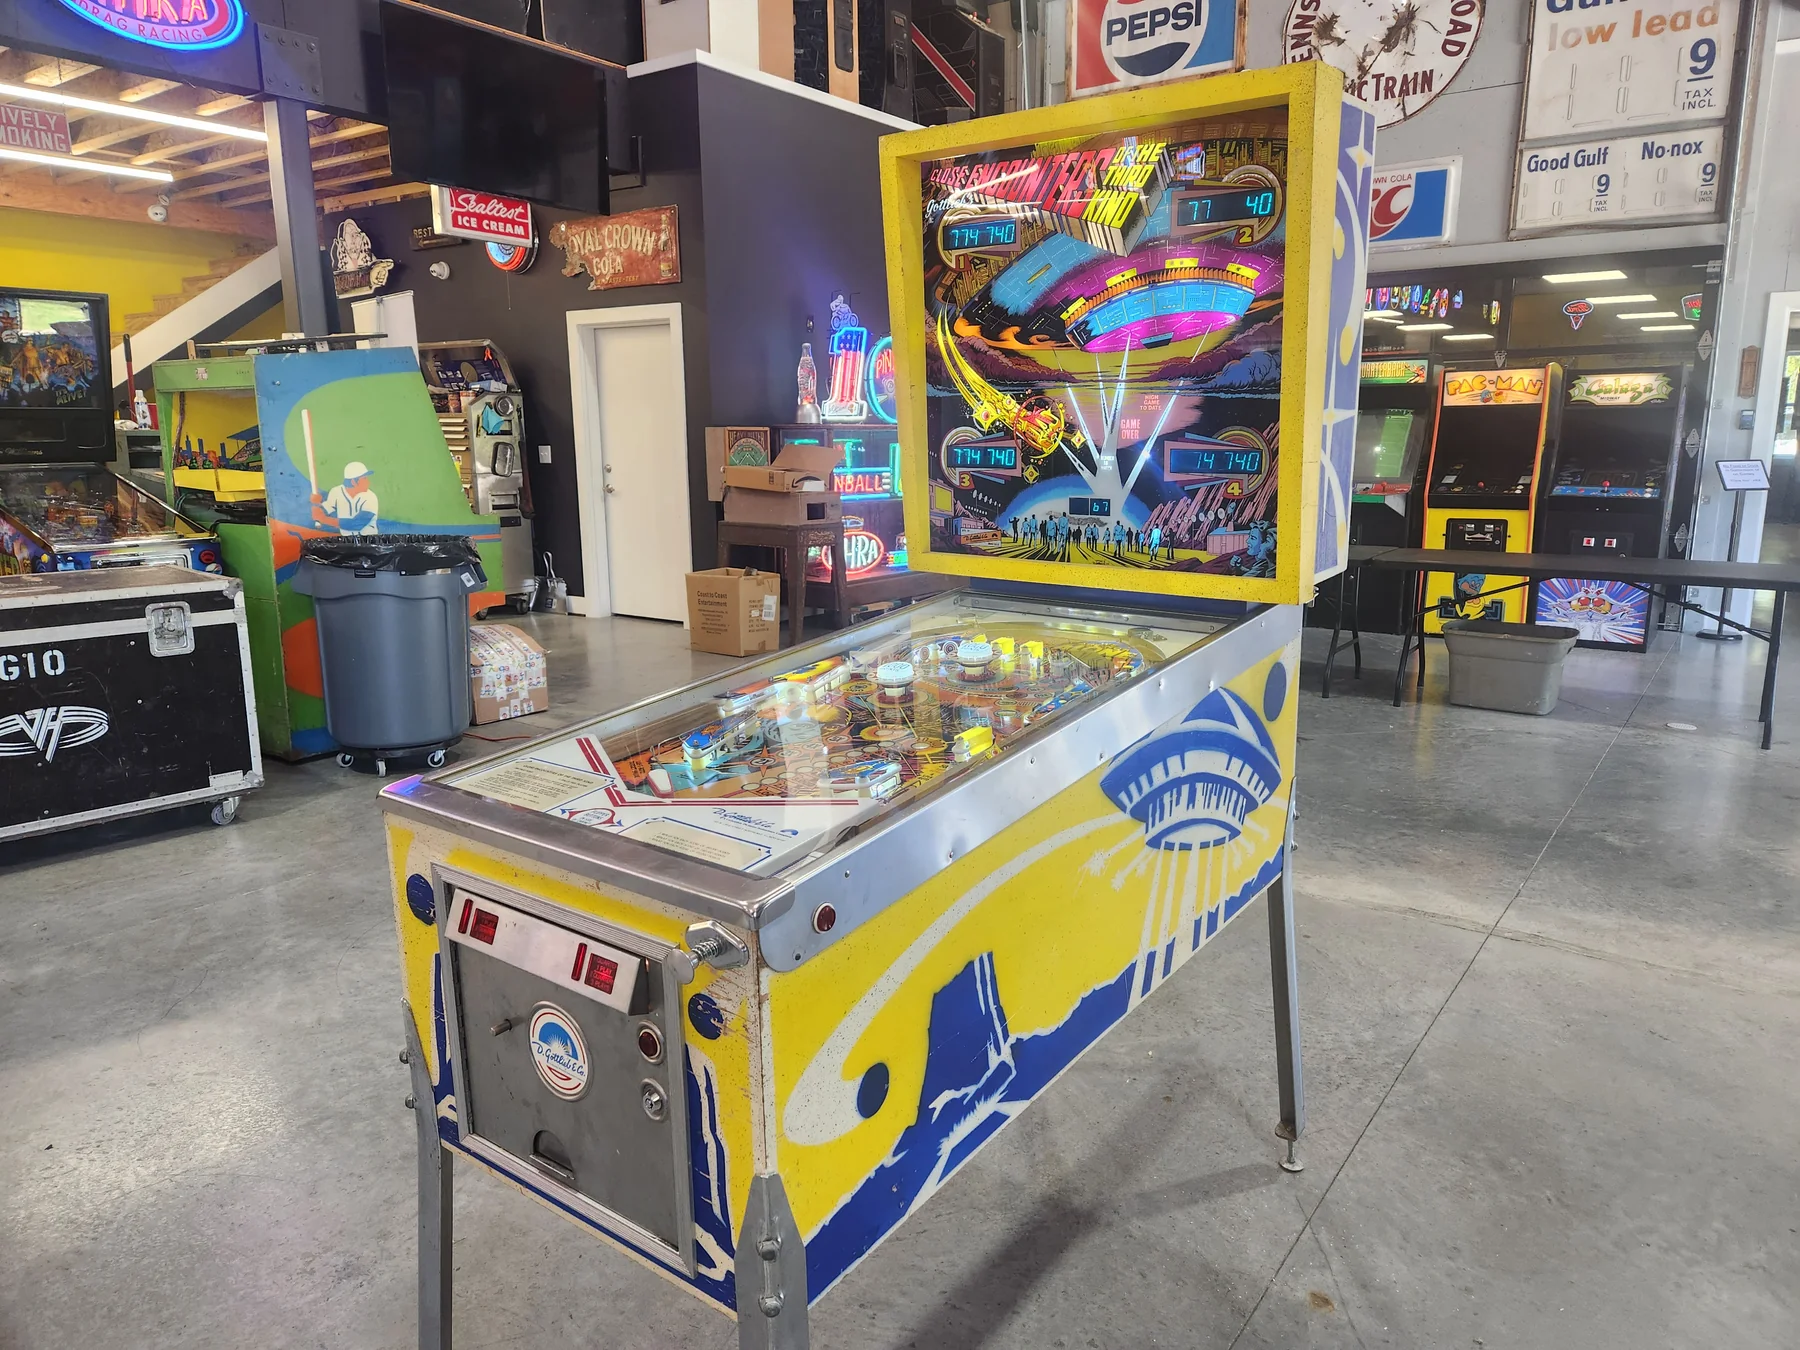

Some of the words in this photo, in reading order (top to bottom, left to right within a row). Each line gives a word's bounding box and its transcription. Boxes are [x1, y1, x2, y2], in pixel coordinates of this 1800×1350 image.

[77, 0, 128, 31] DRAG
[138, 23, 203, 42] RACING
[1106, 0, 1201, 46] PEPSI
[1548, 22, 1618, 51] low
[1632, 2, 1720, 38] lead
[1689, 38, 1717, 76] 9
[1371, 69, 1435, 101] TRAIN
[1685, 87, 1713, 99] TAX
[1135, 142, 1167, 162] THE
[1527, 153, 1570, 173] Good
[1573, 146, 1609, 167] Gulf
[930, 165, 969, 189] CLOSE
[964, 148, 1117, 218] ENCOUNTERS
[1102, 164, 1155, 188] THIRD
[1390, 173, 1413, 183] COLA
[1702, 162, 1717, 183] 9
[1596, 173, 1611, 194] 9
[452, 190, 528, 223] Sealtest
[1081, 188, 1139, 229] KIND
[1246, 192, 1273, 215] 40
[457, 215, 478, 228] ICE
[482, 219, 525, 236] CREAM
[986, 223, 1015, 244] 740
[1239, 226, 1254, 243] 2
[603, 223, 656, 256] CROWN
[593, 255, 624, 276] COLA
[1446, 374, 1544, 396] PAC-MAN
[1120, 418, 1141, 430] GAME
[1121, 429, 1140, 440] OVER
[987, 447, 1015, 467] 740
[1224, 451, 1261, 472] 740
[959, 473, 970, 487] 3
[1226, 481, 1243, 497] 4
[544, 1048, 572, 1070] Gottlieb
